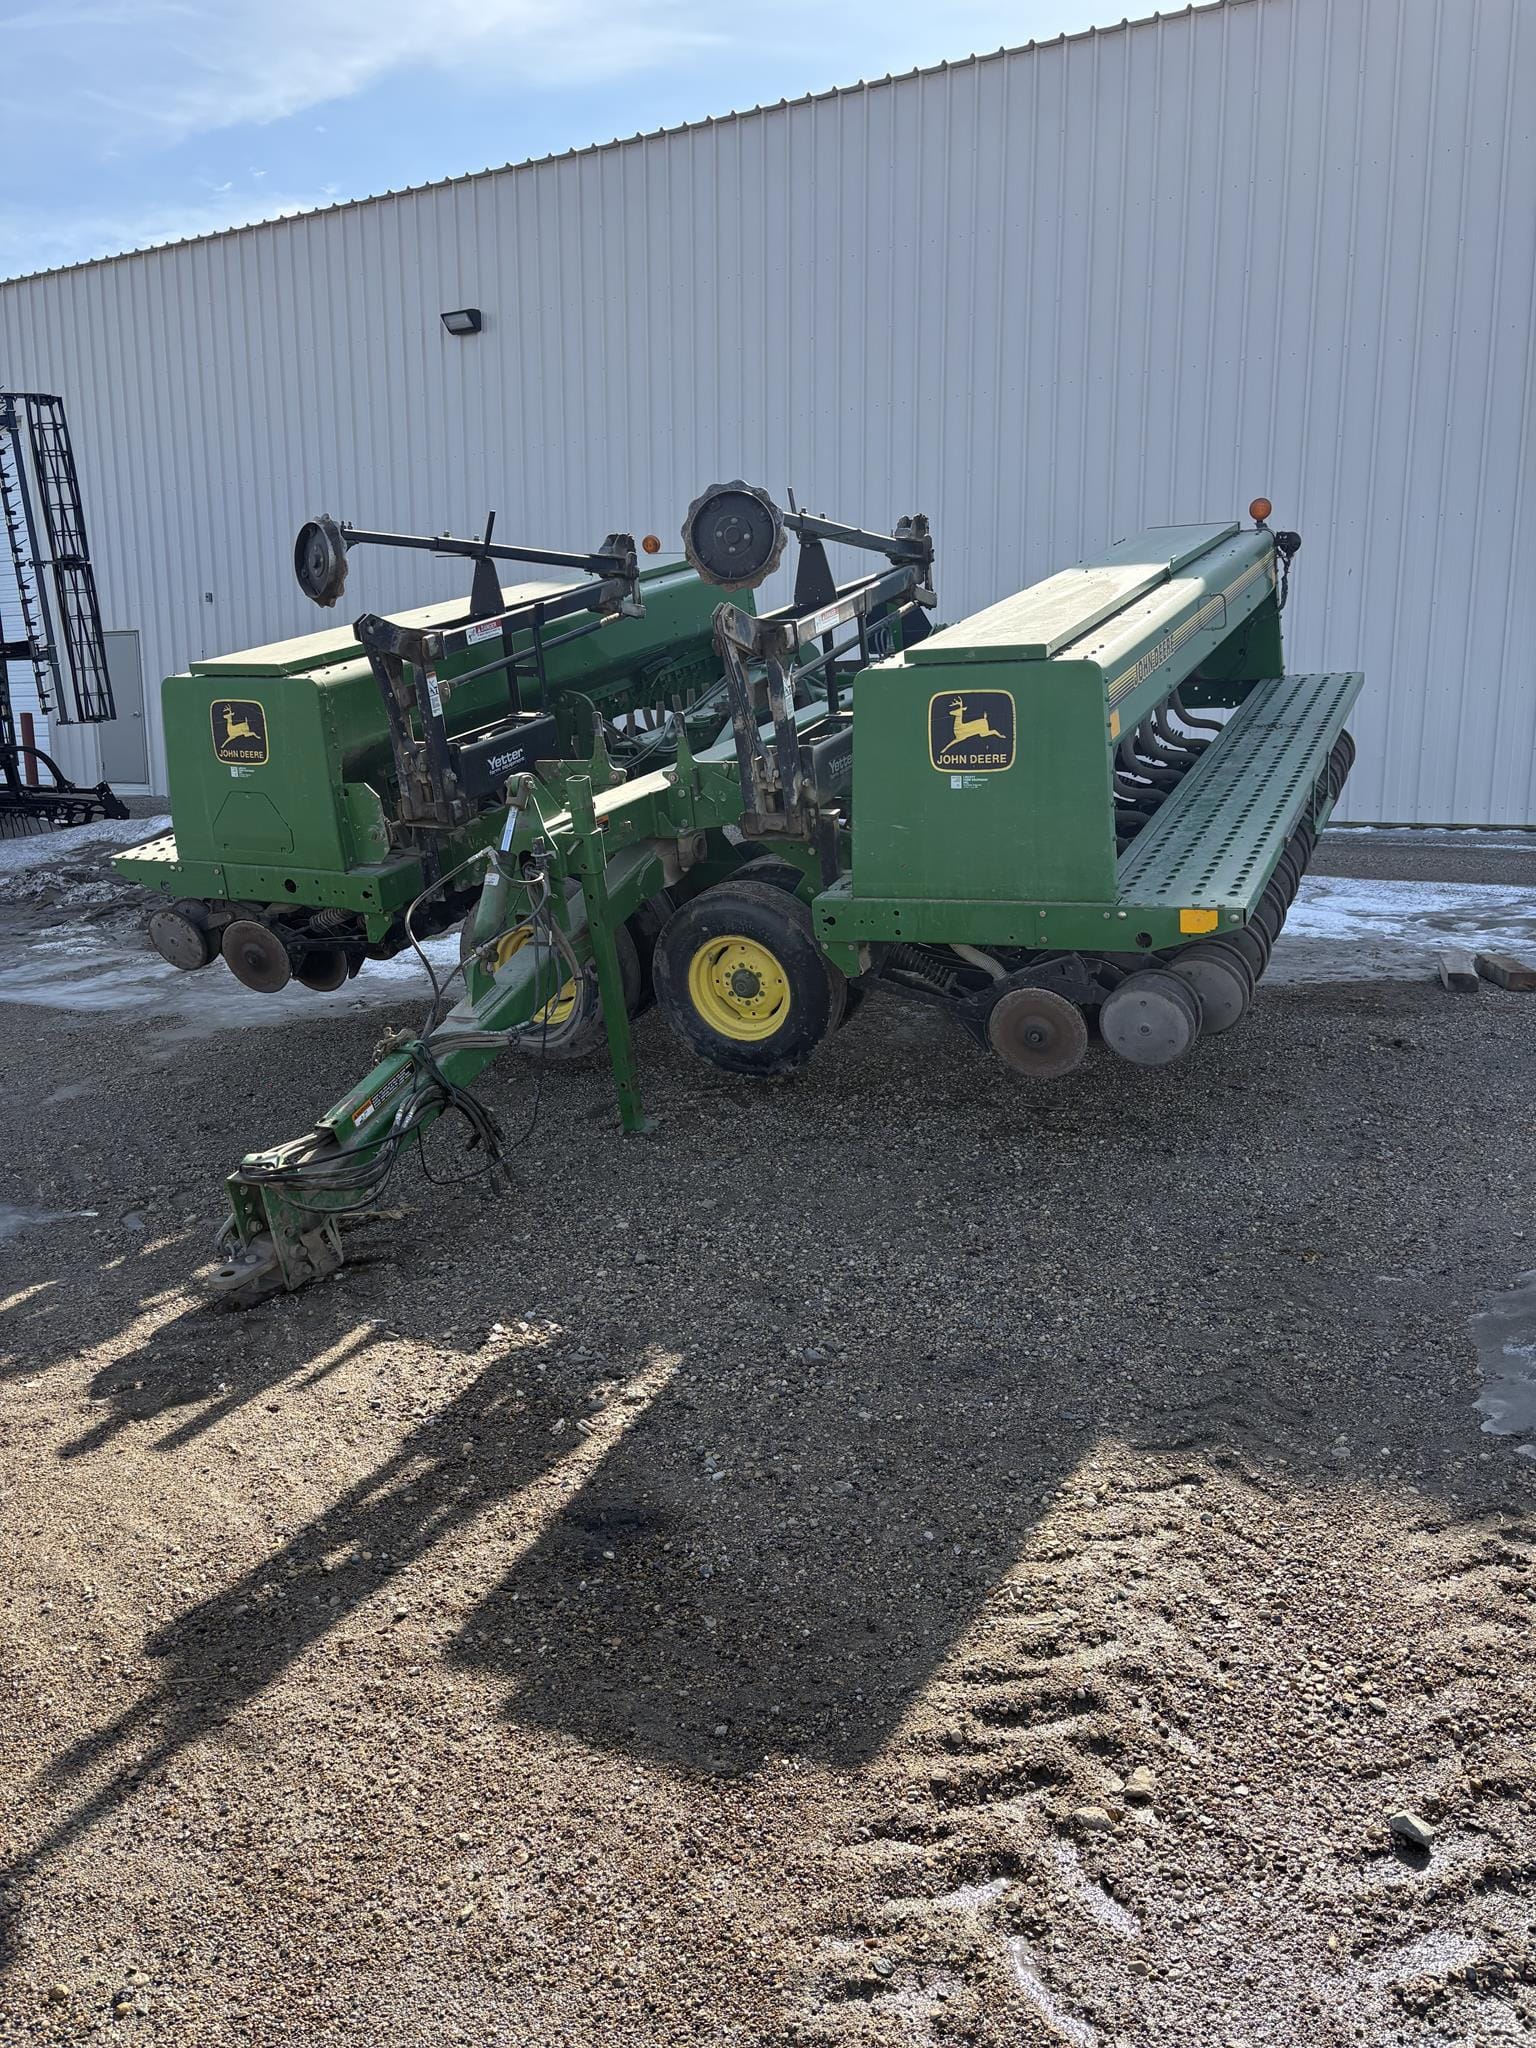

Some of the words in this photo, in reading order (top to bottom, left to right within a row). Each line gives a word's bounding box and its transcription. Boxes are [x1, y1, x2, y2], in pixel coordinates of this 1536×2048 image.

[219, 750, 239, 758] JOHN
[240, 750, 265, 759] DEERE
[487, 748, 523, 770] Yetter
[936, 754, 967, 765] JOHN
[969, 753, 1008, 764] DEERE
[829, 754, 853, 774] Yette
